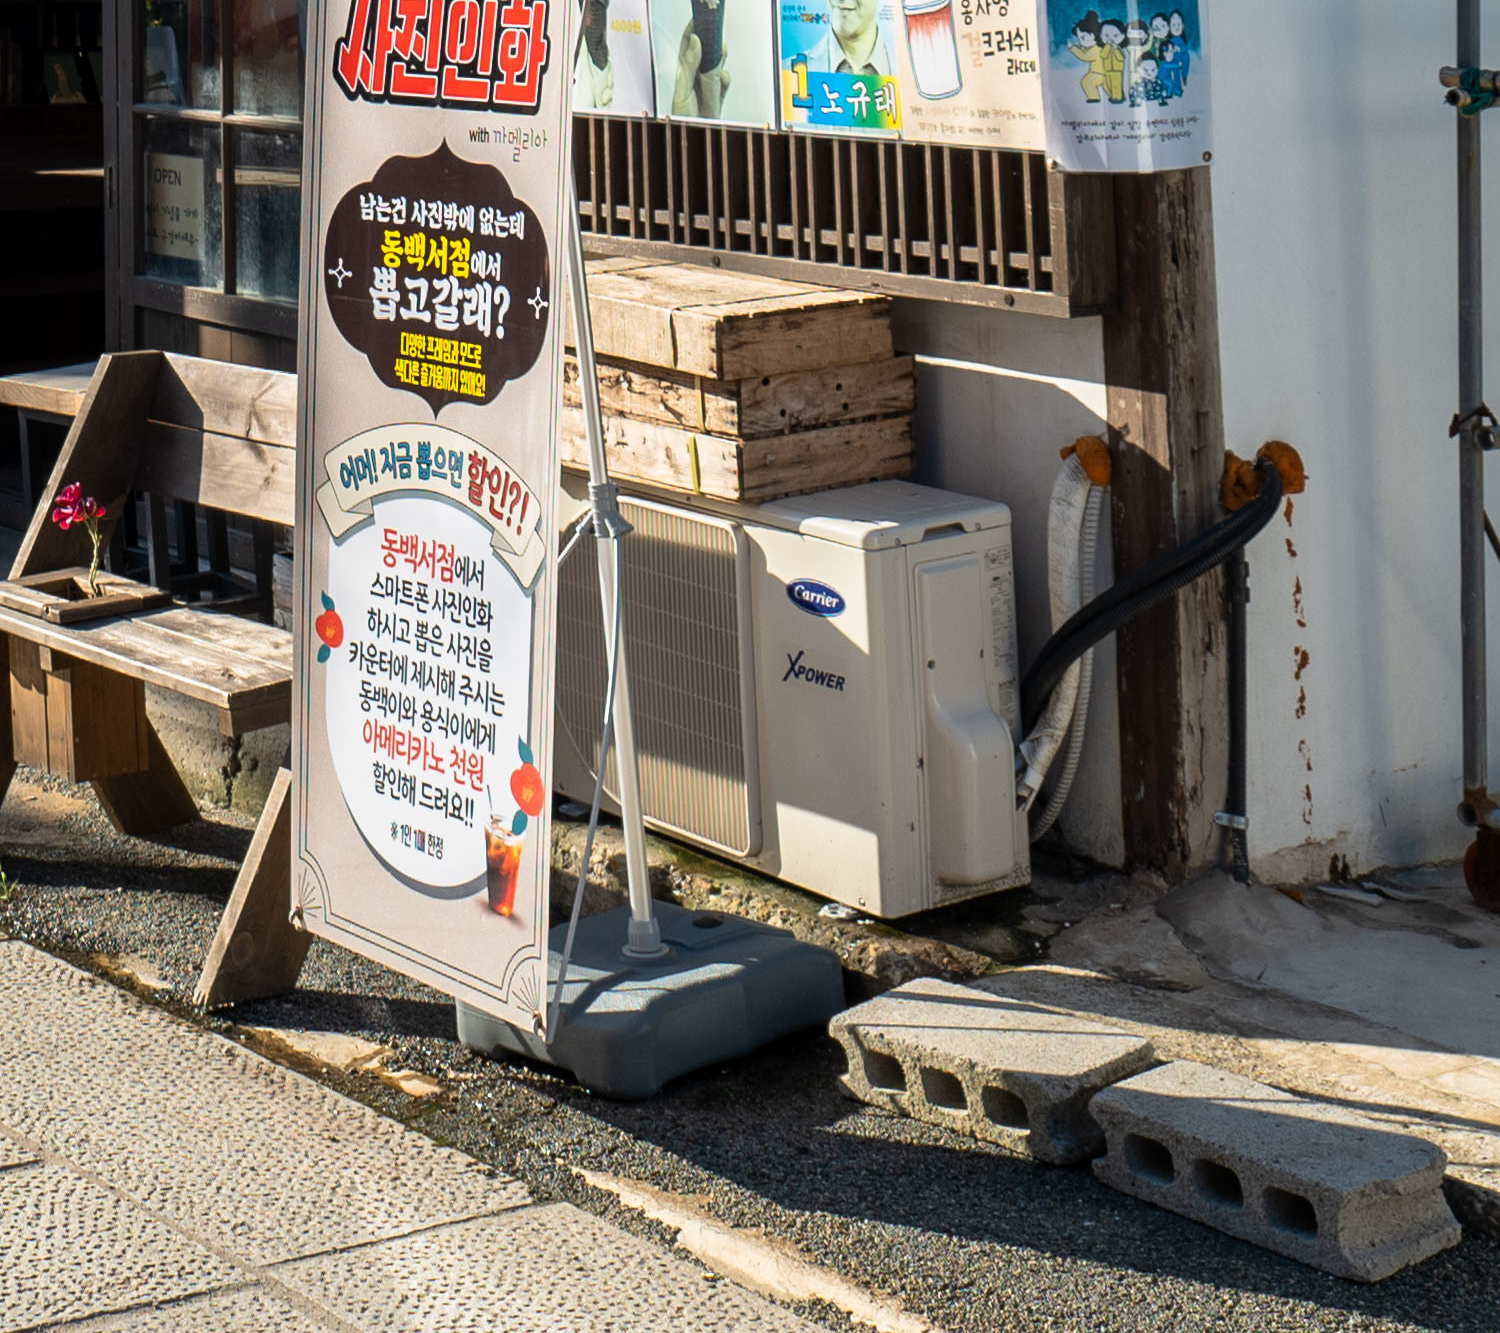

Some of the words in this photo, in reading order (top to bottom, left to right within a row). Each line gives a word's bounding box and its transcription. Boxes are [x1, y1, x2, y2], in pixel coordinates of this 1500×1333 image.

[961, 27, 1029, 68] 걸크러쉬
[791, 53, 814, 108] 1
[820, 80, 898, 124] 노규태
[469, 127, 490, 143] with
[494, 126, 548, 163] 까멜리아
[155, 168, 182, 186] OPEN
[360, 193, 407, 225] 남는건
[411, 200, 474, 234] 사진밖에
[479, 207, 525, 240] 없는데
[381, 230, 501, 282] 동백서점에서
[369, 266, 511, 339] 뽑고갈래?
[394, 357, 419, 385] 색다른
[420, 362, 459, 393] 즐거움까지
[400, 332, 426, 358] 다양한
[426, 336, 459, 365] 프레임과
[459, 342, 482, 379] 모드로
[340, 448, 378, 491] 어머!
[380, 441, 413, 479] 지금
[416, 441, 464, 489] 뽑으면
[468, 450, 529, 536] 할인?!
[381, 528, 485, 591] 동백서점에서
[370, 572, 430, 614] 스마트폰
[432, 588, 494, 633] 사진인화
[794, 584, 840, 609] Carrier
[367, 607, 411, 645] 하시고
[414, 619, 444, 658] 뽑은
[446, 632, 493, 673] 사진을
[349, 641, 408, 686] 카운터에
[411, 660, 455, 701] 제시해
[459, 675, 505, 717] 주시는
[782, 650, 846, 692] XPOWER
[358, 679, 418, 727] 동백이와
[420, 700, 496, 755] 용식이에게
[362, 718, 445, 774] 아메리카노
[449, 744, 484, 792] 천원
[373, 761, 417, 807] 할인해
[418, 781, 474, 829] 드려요!!
[400, 824, 412, 847] 1인
[427, 833, 444, 860] 한정
